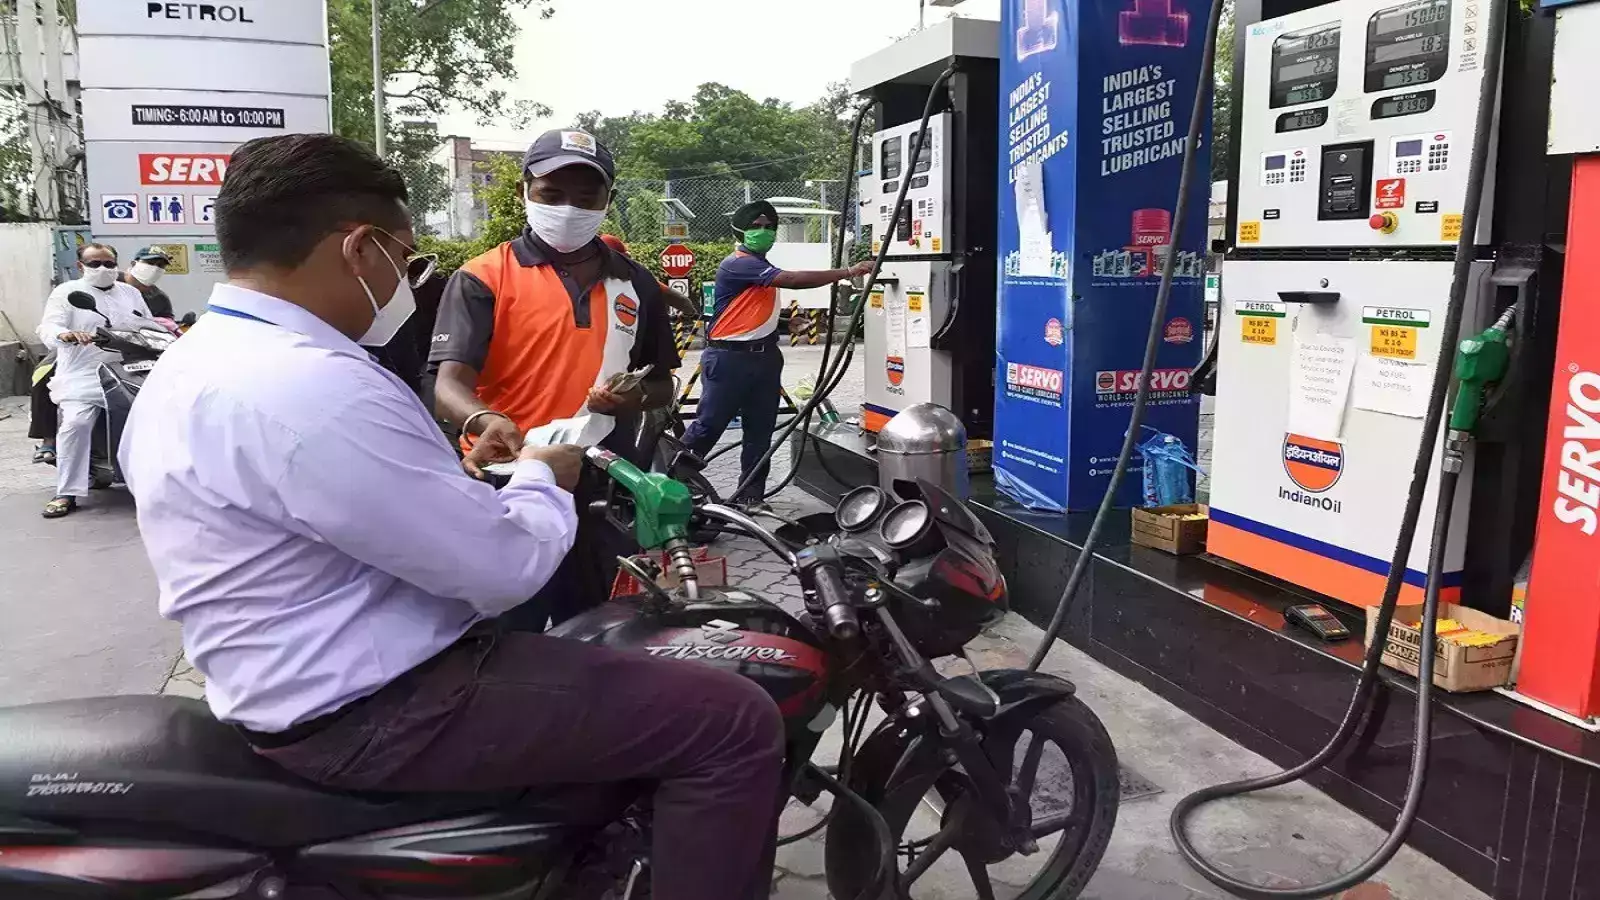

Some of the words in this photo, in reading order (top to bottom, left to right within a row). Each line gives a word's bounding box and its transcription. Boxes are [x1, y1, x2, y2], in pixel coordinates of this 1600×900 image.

[147, 2, 254, 24] PETROL
[1009, 81, 1051, 127] LARGEST
[1103, 79, 1176, 115] LARGEST
[179, 108, 201, 123] 6:00
[202, 109, 218, 124] AM
[220, 110, 235, 125] to
[238, 111, 265, 125] 10:00
[266, 111, 281, 125] PM
[1009, 105, 1048, 146] SELLING
[1102, 101, 1171, 135] SELLING
[1009, 123, 1051, 165] TRUSTED
[1101, 120, 1174, 155] TRUSTED
[148, 156, 228, 183] SERV
[1137, 234, 1164, 245] SERVO
[662, 253, 693, 268] STOP
[1245, 302, 1275, 311] PETROL
[1376, 308, 1415, 320] PETROL
[1020, 367, 1060, 391] SERVO
[1098, 393, 1137, 402] WORLD-CLA
[1148, 390, 1189, 400] LUBRICANTS
[1553, 370, 1600, 536] SERVO
[1278, 485, 1342, 514] IndianOil
[31, 772, 79, 783] BAJAJ
